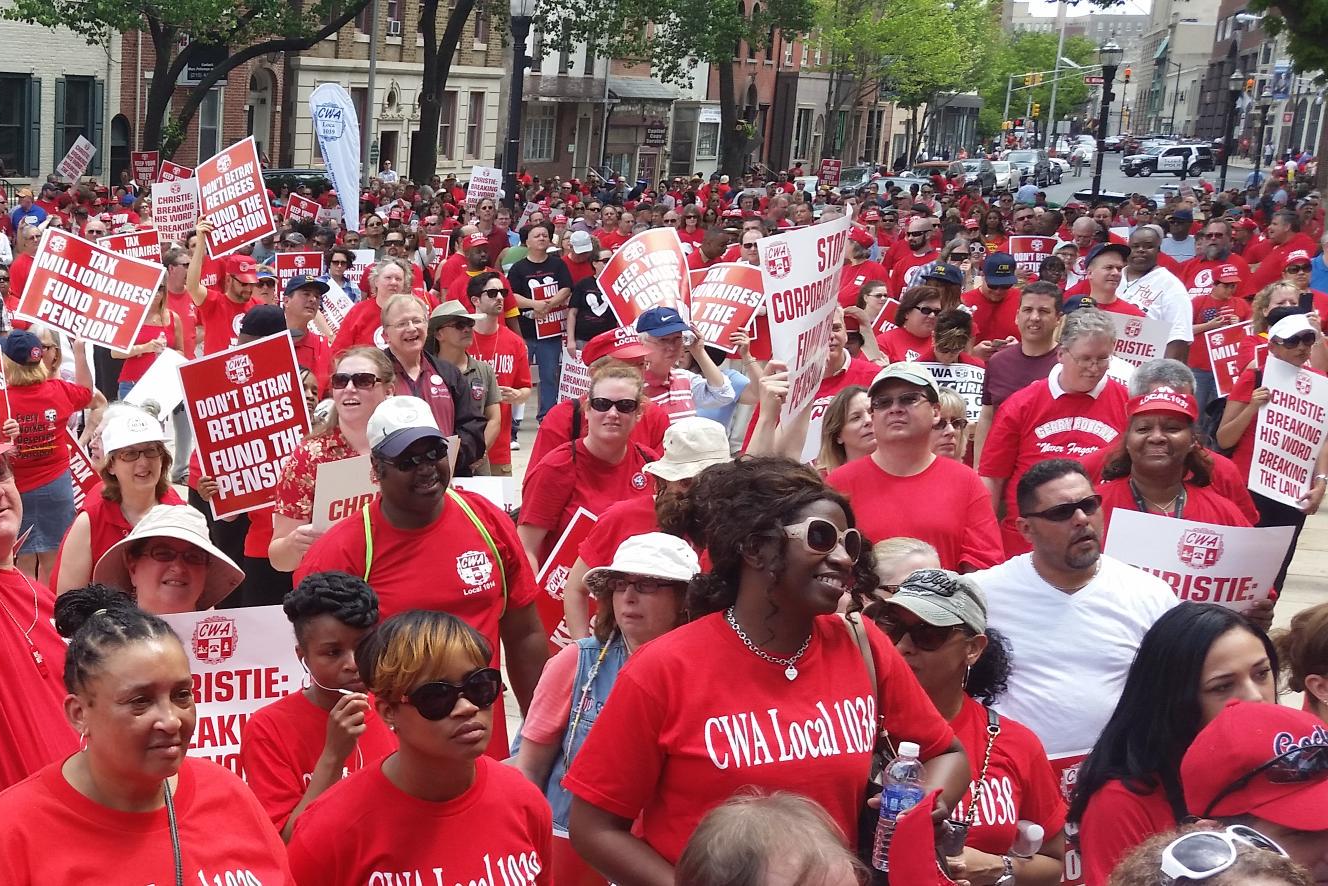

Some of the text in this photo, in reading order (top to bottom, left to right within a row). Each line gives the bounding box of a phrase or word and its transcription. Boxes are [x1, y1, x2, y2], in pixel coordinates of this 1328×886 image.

[317, 107, 342, 120] CWA
[201, 160, 254, 198] DON'T BETRAY
[470, 184, 498, 192] BREAKING
[473, 176, 498, 186] CHRISTIE:
[158, 192, 193, 205] CHRISTIE:
[205, 176, 255, 211] RETIREES
[154, 212, 192, 223] HIS WORD
[156, 203, 194, 215] BREAKING
[206, 193, 263, 230] FUND THE
[157, 220, 194, 233] BREAKING
[160, 232, 175, 240] THE
[210, 208, 267, 247] PENSION
[124, 235, 140, 247] TAX
[768, 245, 787, 260] CWA
[817, 230, 846, 273] STOP
[88, 250, 120, 276] TAX
[1014, 252, 1034, 261] DON'T
[38, 251, 152, 306] MILLIONAIRES
[279, 268, 298, 277] DON'T
[611, 262, 640, 296] KEEP
[42, 277, 130, 325] FUND THE
[37, 299, 119, 344] PENSION
[701, 301, 738, 326] THE
[1115, 339, 1156, 358] RISTIE:
[228, 356, 249, 370] CWA
[497, 354, 514, 374] 1038
[196, 371, 293, 420] DON'T BETRAY
[560, 383, 569, 392] HIS
[1139, 393, 1171, 406] LOCAL
[1270, 388, 1326, 424] CHRISTIE:
[207, 396, 295, 443] RETIREES
[1034, 417, 1073, 440] GERRY
[1266, 408, 1322, 445] BREAKING
[1260, 425, 1280, 447] HIS
[1280, 433, 1312, 462] WORD
[70, 451, 94, 484] TAX
[209, 438, 268, 476] FUND
[1258, 448, 1308, 484] BREAKING
[1260, 468, 1300, 500] THE LAW
[1185, 532, 1219, 547] CWA
[460, 555, 486, 568] CWA
[463, 585, 482, 596] Local
[548, 568, 567, 592] CWA
[1150, 569, 1258, 603] RISTIE:
[199, 622, 231, 638] CWA
[191, 666, 289, 705] RISTIE:
[704, 695, 877, 770] CWA Local 1038
